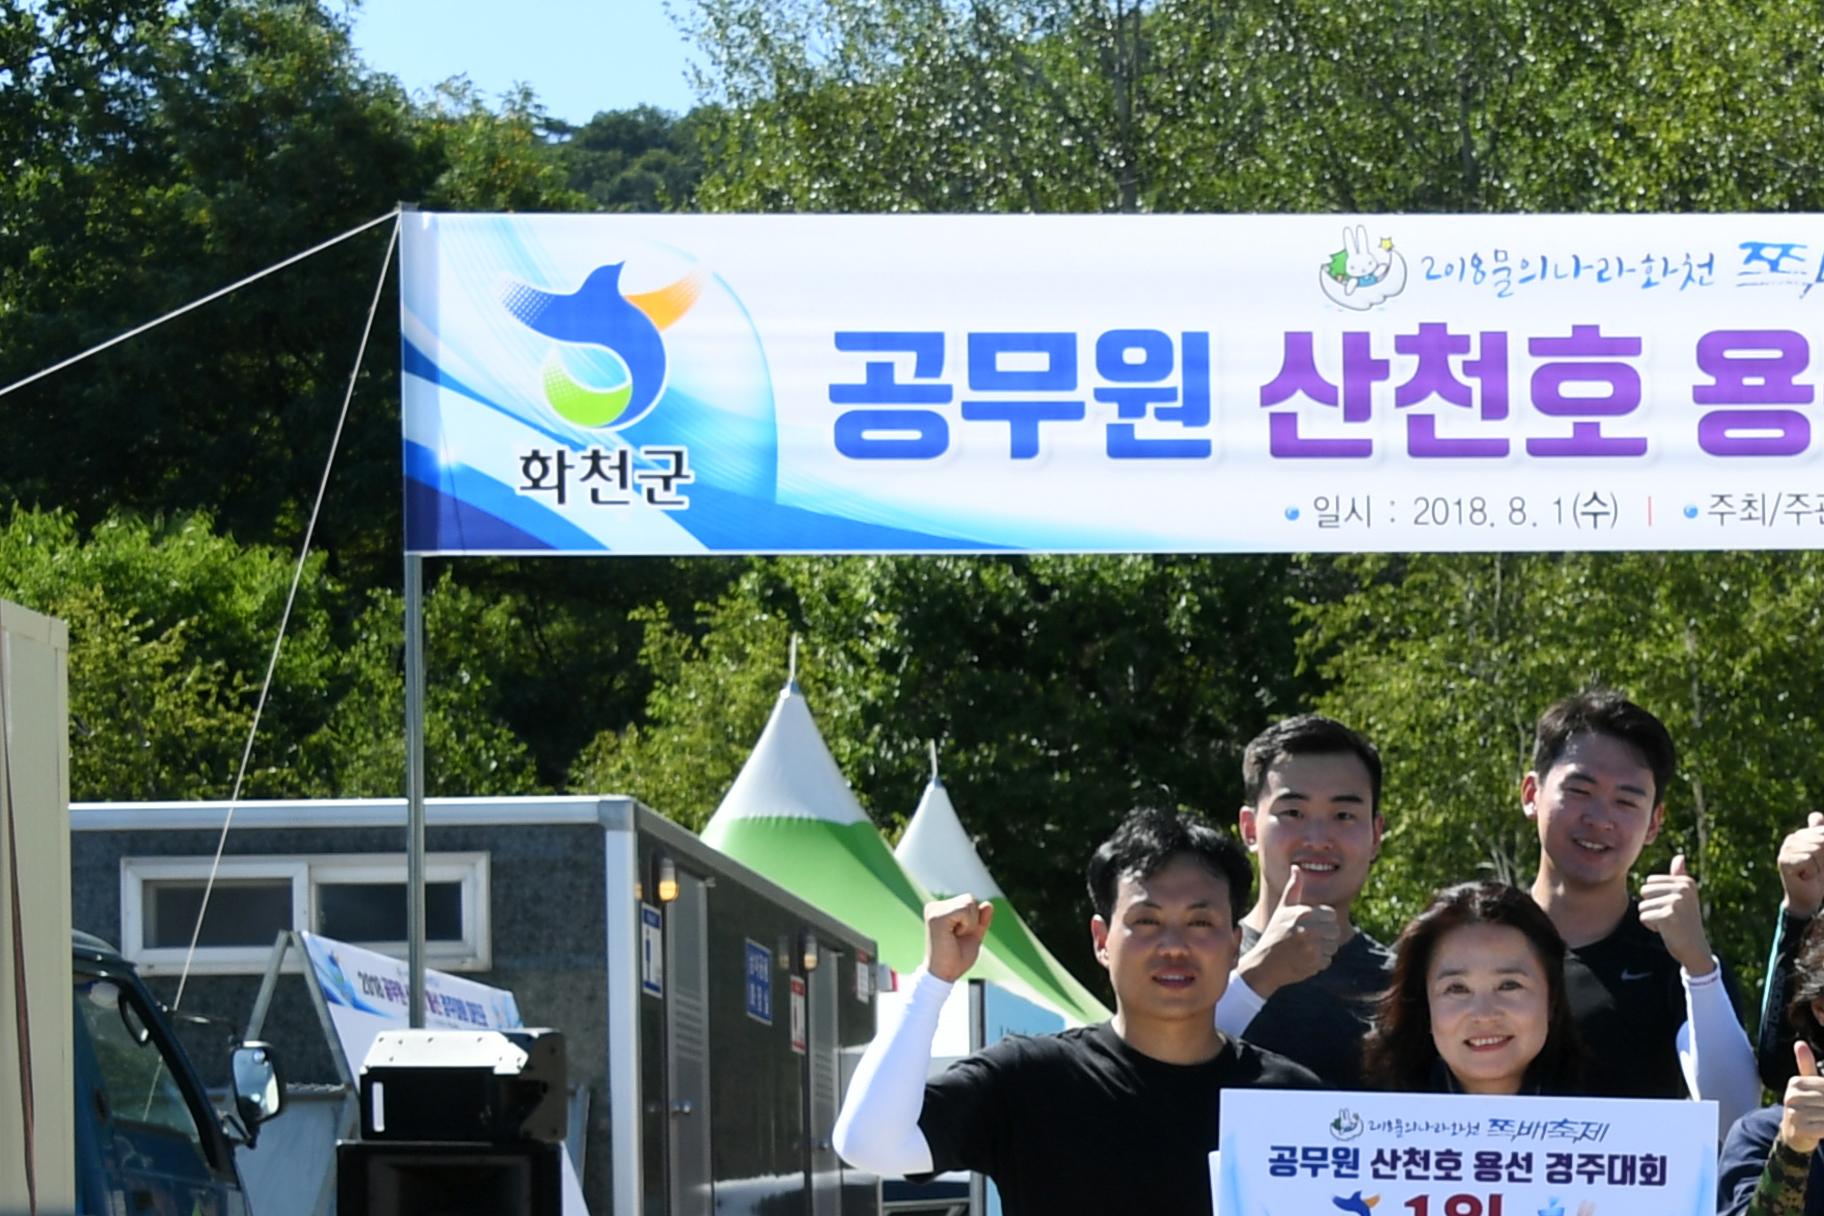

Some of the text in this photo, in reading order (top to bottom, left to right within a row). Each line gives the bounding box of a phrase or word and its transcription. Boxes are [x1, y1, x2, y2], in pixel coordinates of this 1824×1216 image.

[829, 328, 1213, 460] 공무원
[1259, 322, 1648, 458] 산천호
[516, 446, 692, 509] 화천군
[1313, 494, 1372, 528] 일시
[1412, 495, 1495, 528] 2018.
[1552, 491, 1618, 530] 1(수)
[1268, 1144, 1668, 1187] 공무원 산천호 용선 경주대회
